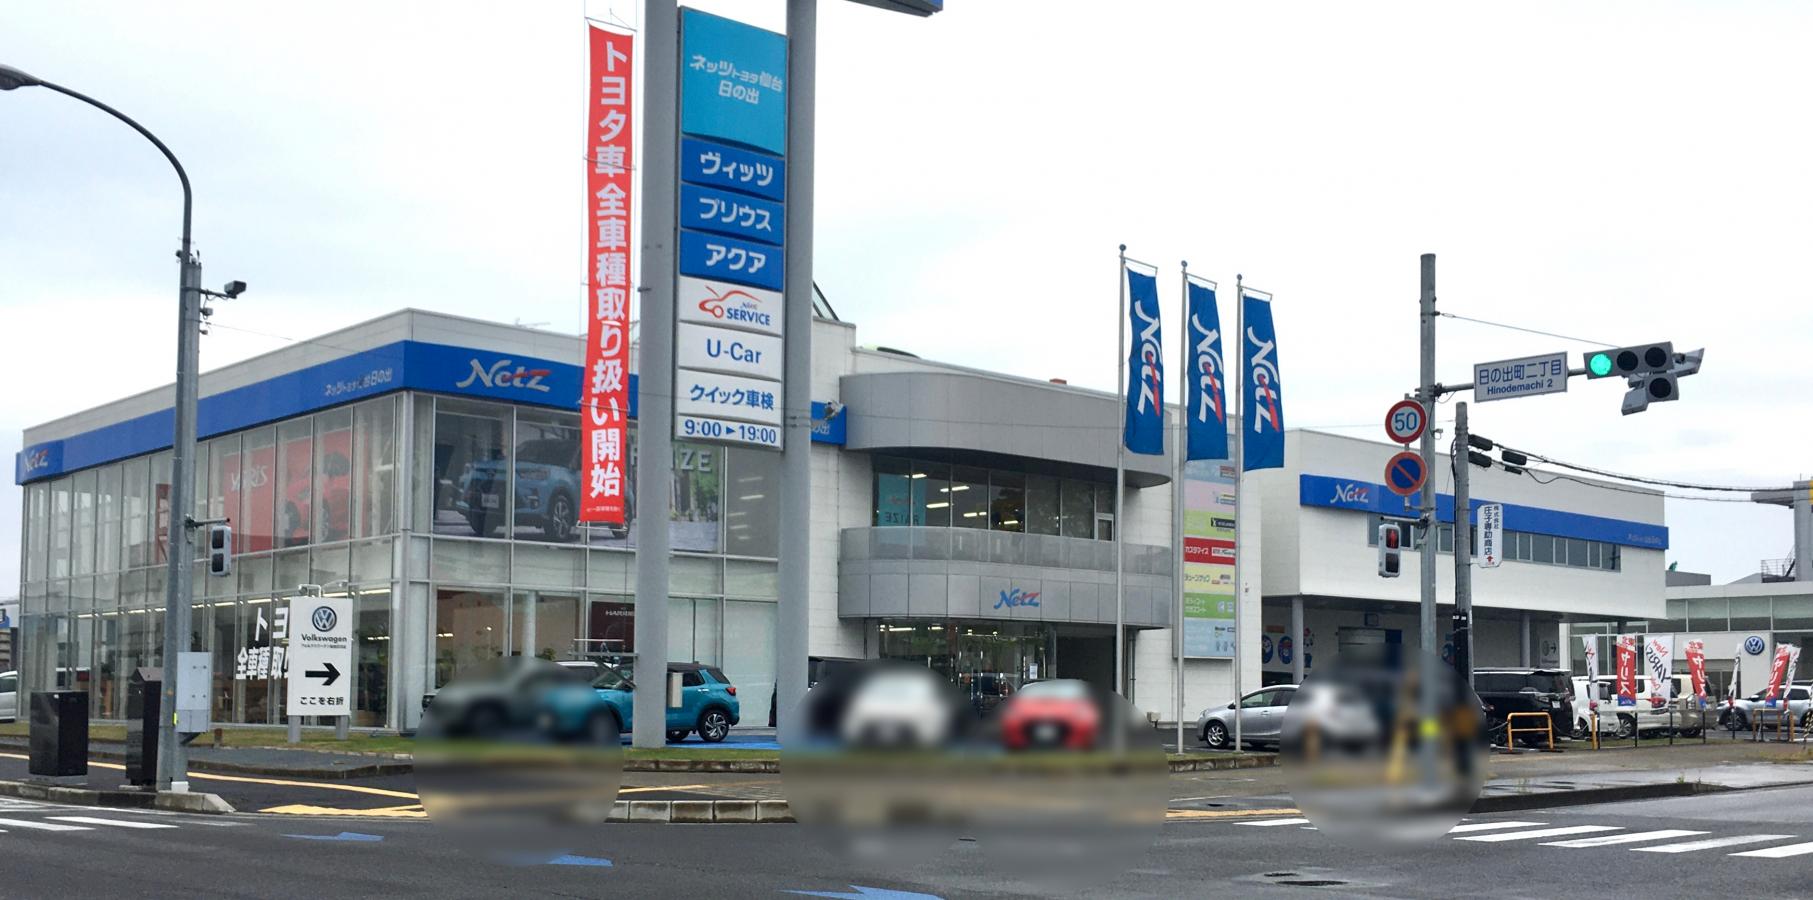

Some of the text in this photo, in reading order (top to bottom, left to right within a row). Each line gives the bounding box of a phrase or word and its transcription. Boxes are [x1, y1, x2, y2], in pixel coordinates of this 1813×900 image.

[689, 54, 783, 91] ネッツトヨタ仙台
[718, 81, 759, 105] 日の出
[700, 152, 774, 186] ヴィッツ
[699, 197, 772, 232] プリウス
[589, 40, 628, 498] トヨタ車全車種取り扱い開始
[706, 244, 766, 274] アクア
[726, 307, 770, 326] SERVICE
[706, 338, 762, 364] U-Car
[1134, 300, 1163, 417] Netz
[456, 358, 551, 393] Netz
[1191, 312, 1224, 425] Netz
[1247, 326, 1280, 433] Netz
[1479, 359, 1563, 386] 日の出町二丁目
[690, 384, 774, 411] クイック車検
[1487, 379, 1553, 396] Hinodemachi 2
[684, 420, 777, 445] 9:00 19:00
[1394, 412, 1418, 432] 50
[1330, 483, 1369, 504] Netz
[993, 587, 1041, 610] Netz
[301, 633, 347, 643] Volkswagen
[300, 696, 345, 706] ここを右折
